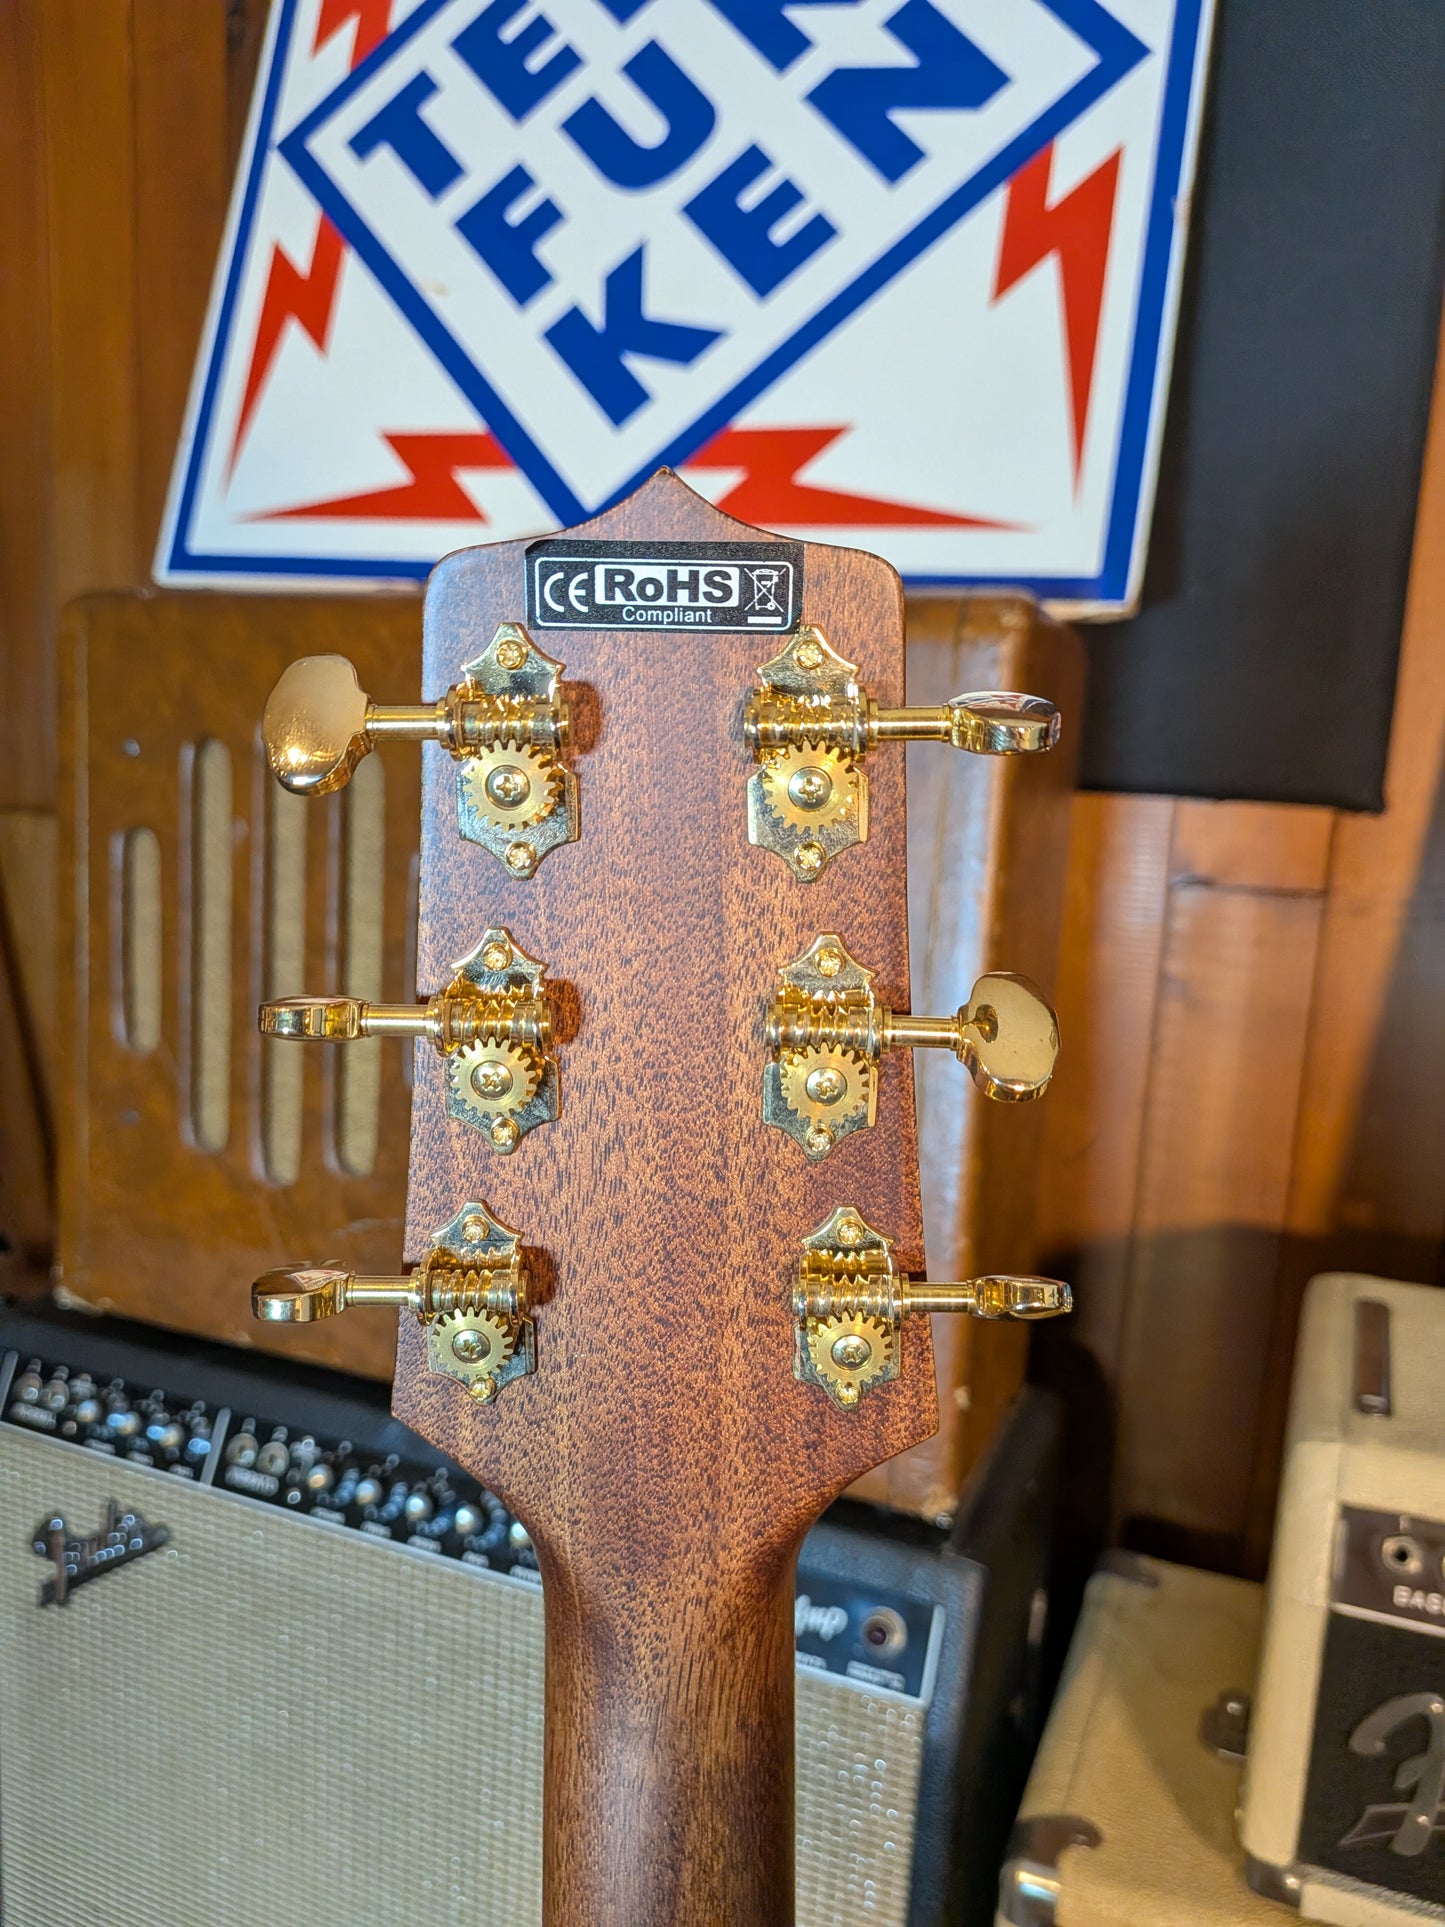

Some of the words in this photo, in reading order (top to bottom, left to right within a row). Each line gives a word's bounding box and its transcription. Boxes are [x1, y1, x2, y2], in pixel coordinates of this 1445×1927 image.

[543, 0, 1012, 429] KEN
[604, 567, 733, 604] RoHS
[622, 606, 712, 624] Compliant
[1393, 1585, 1445, 1615] BAS
